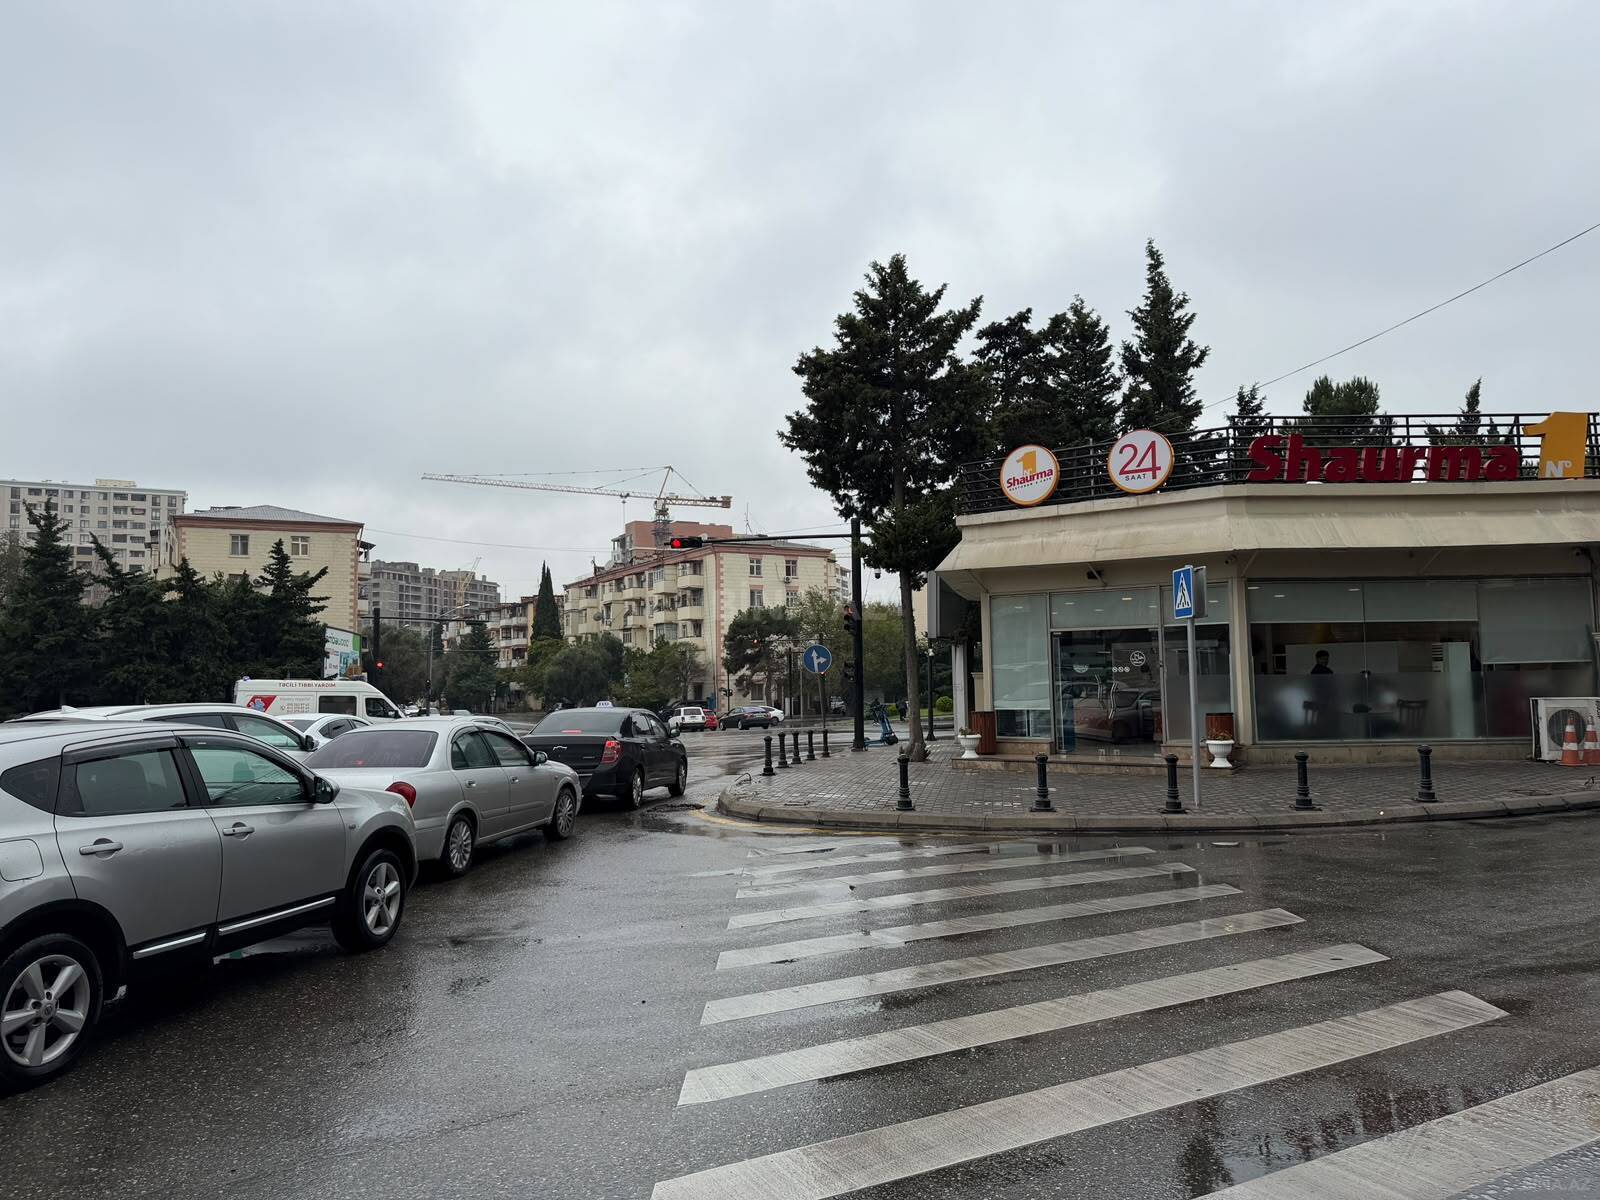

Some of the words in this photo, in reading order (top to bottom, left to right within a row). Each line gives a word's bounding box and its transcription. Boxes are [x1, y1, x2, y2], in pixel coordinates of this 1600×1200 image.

[1119, 440, 1162, 480] 24
[1246, 433, 1520, 482] Shaurma
[1522, 411, 1588, 479] 1
[1006, 468, 1053, 489] Shaurma
[1125, 473, 1146, 481] SAAT
